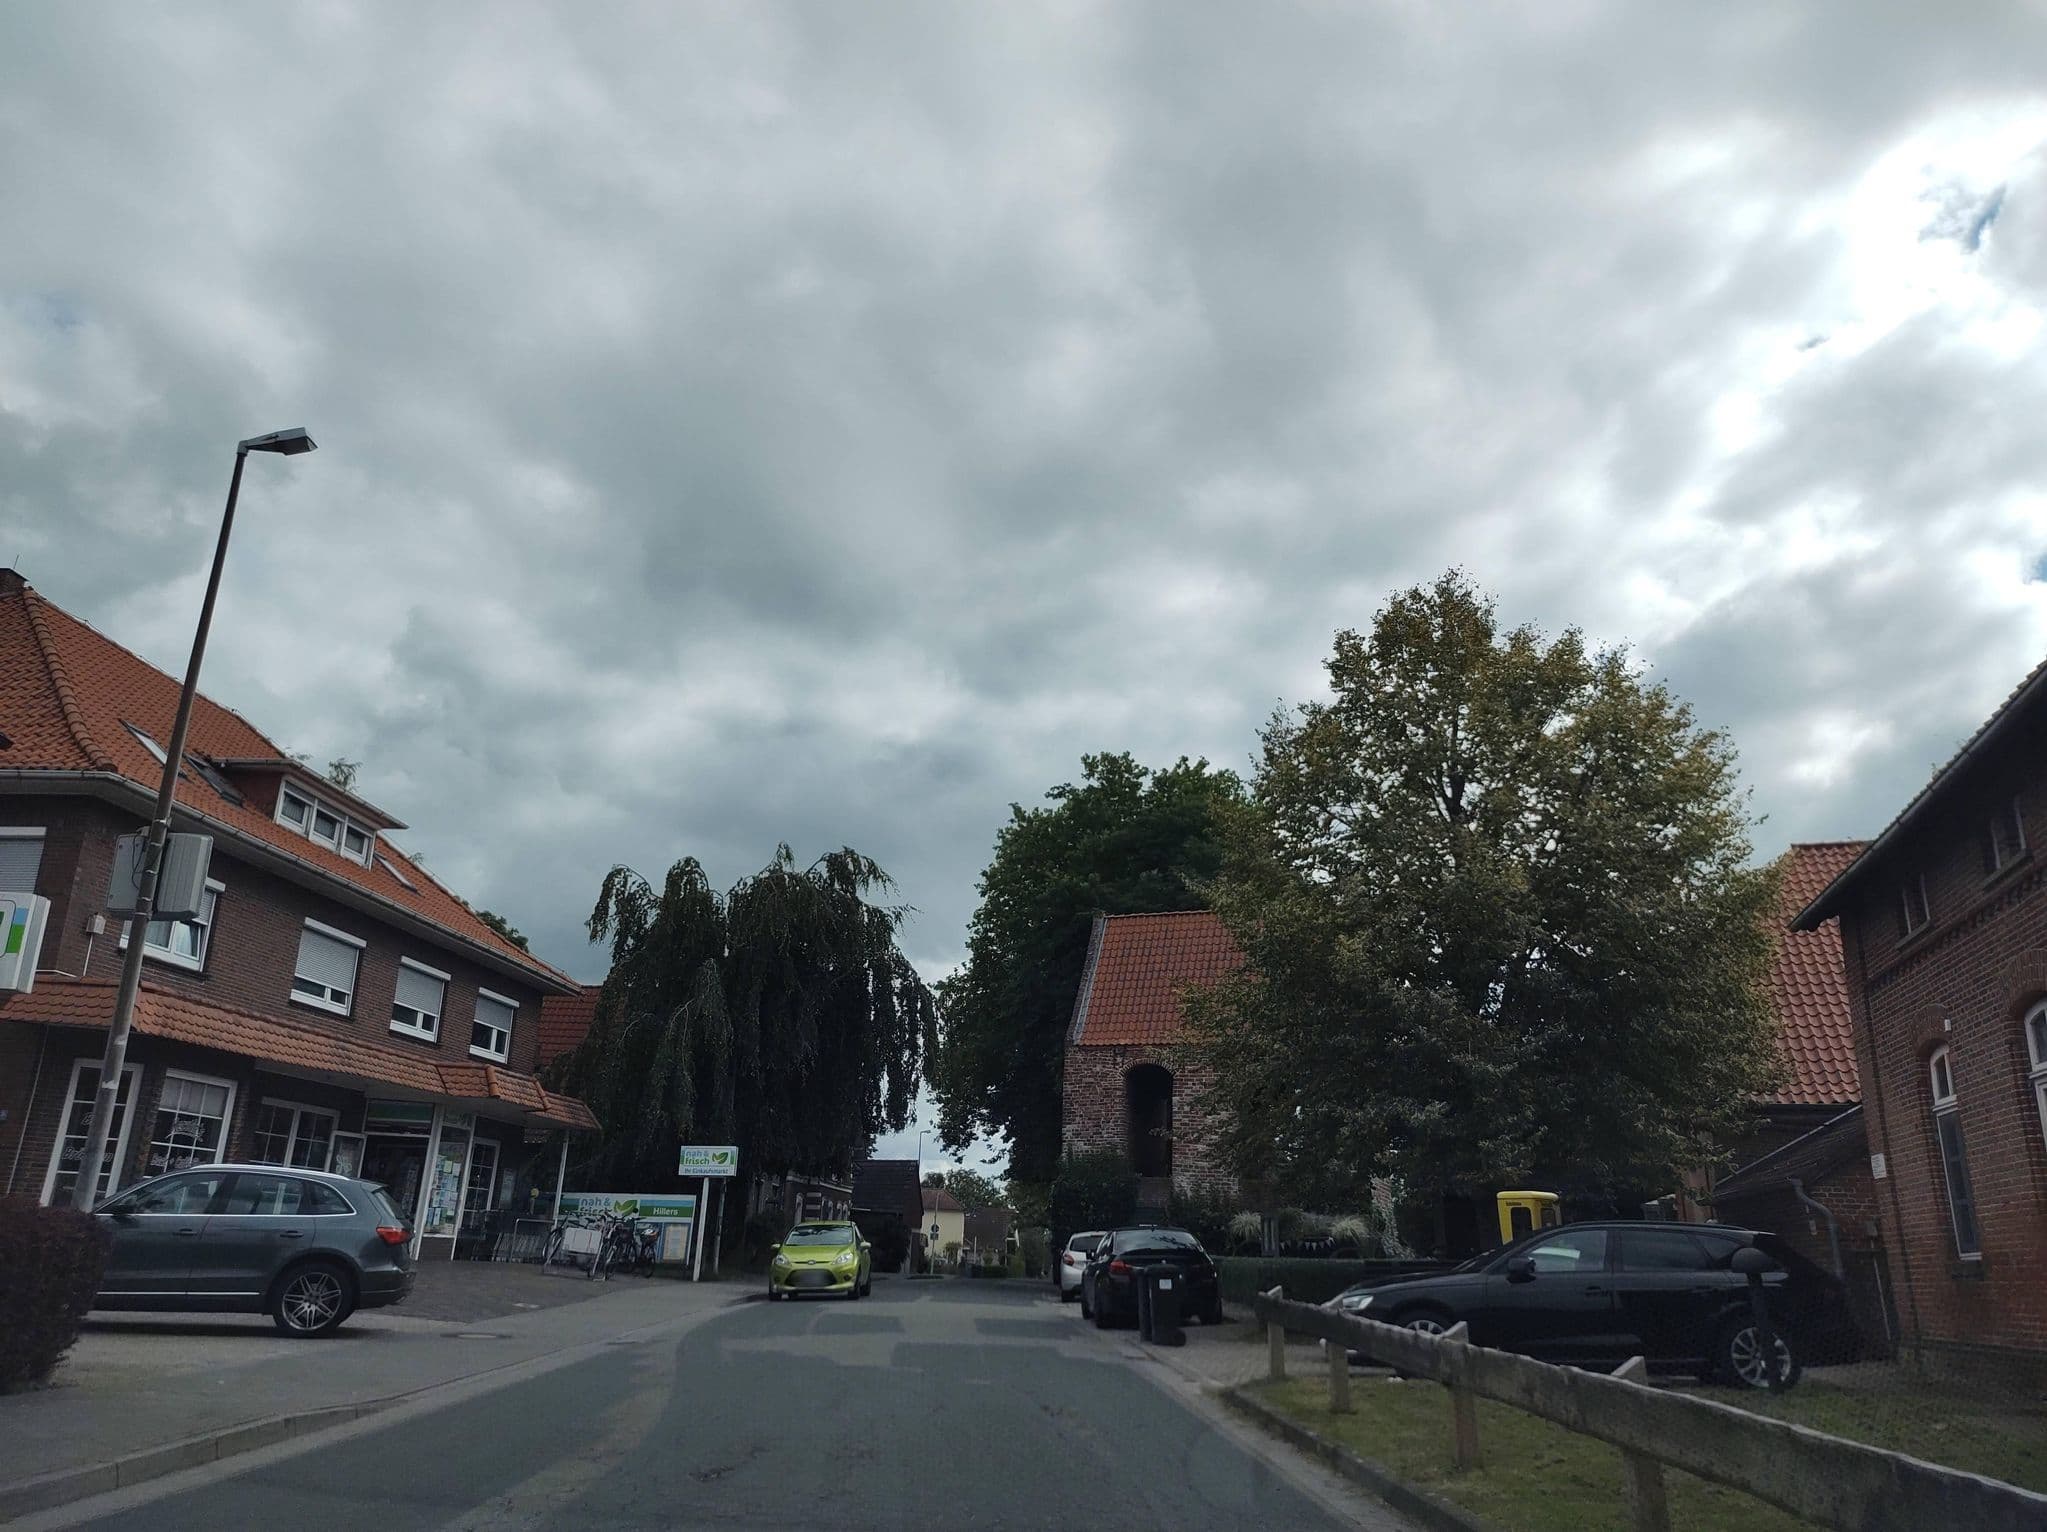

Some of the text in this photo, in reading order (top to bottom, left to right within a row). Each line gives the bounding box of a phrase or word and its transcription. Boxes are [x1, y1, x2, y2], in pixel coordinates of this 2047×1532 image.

[685, 1157, 710, 1165] frisch
[580, 1197, 611, 1207] nah &
[653, 1207, 678, 1215] Hillers
